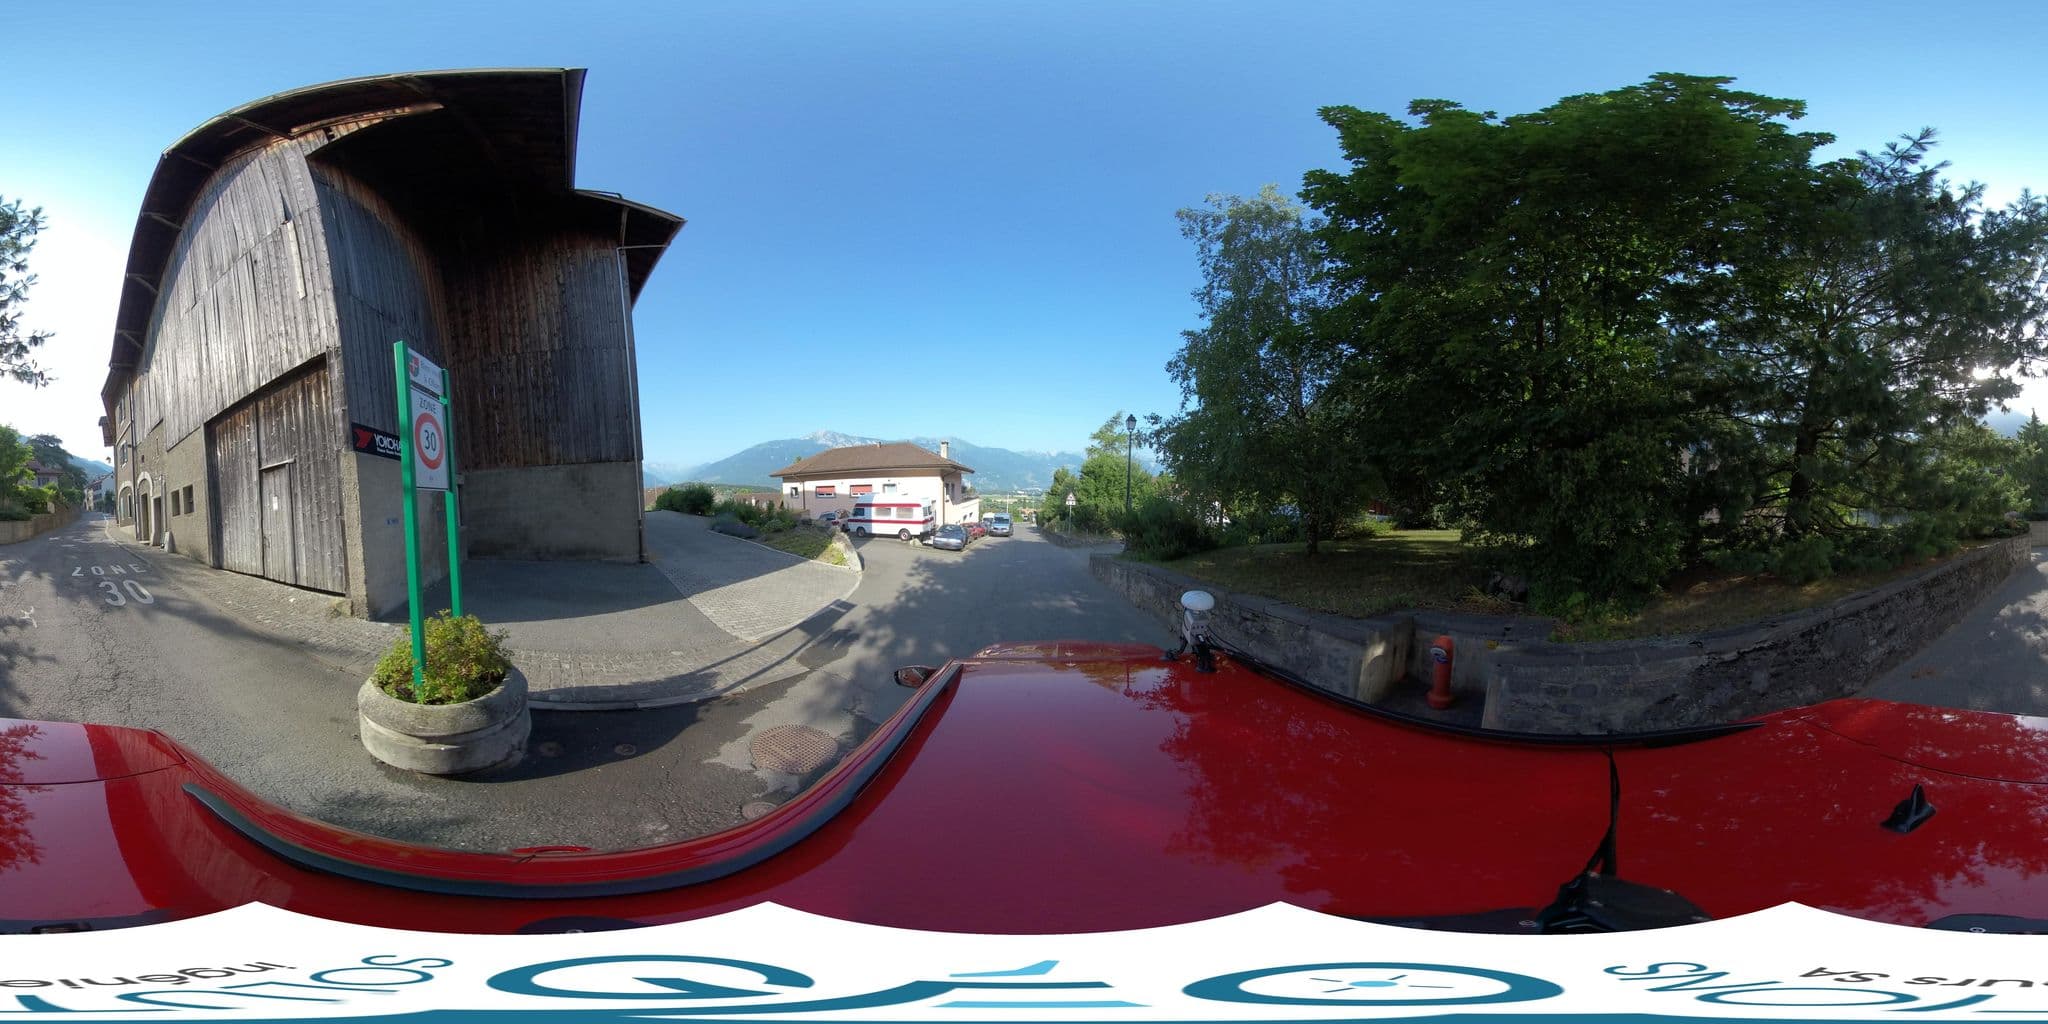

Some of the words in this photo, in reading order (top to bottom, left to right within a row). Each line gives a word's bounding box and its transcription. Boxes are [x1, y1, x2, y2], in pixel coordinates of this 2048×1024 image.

[418, 397, 437, 415] ZONE
[424, 429, 437, 452] 30
[71, 563, 147, 577] ZONE
[98, 579, 155, 606] 30
